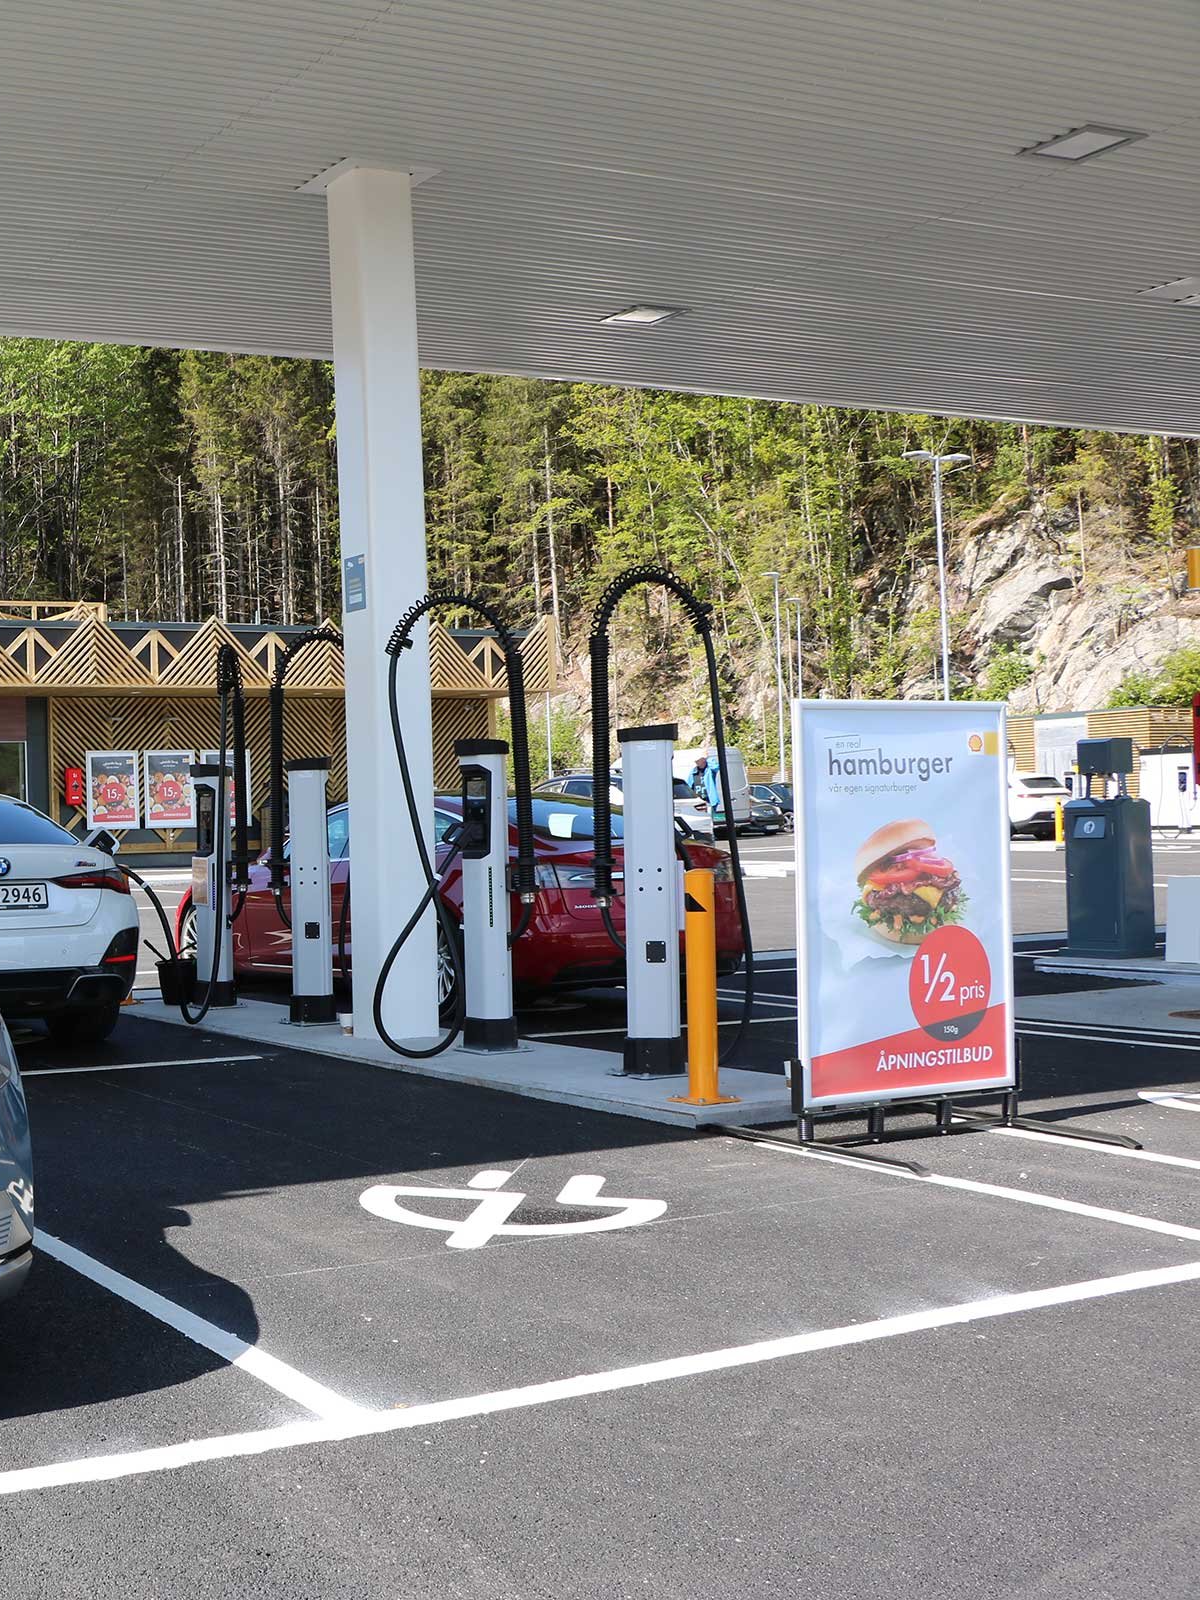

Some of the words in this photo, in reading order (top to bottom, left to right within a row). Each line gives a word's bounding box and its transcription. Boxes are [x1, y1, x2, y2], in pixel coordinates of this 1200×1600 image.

[828, 747, 953, 782] hamburger
[844, 785, 863, 795] egen
[960, 979, 986, 1007] pris
[943, 1025, 959, 1035] 150g
[876, 1045, 993, 1073] ÅPNINGSTILBUD
